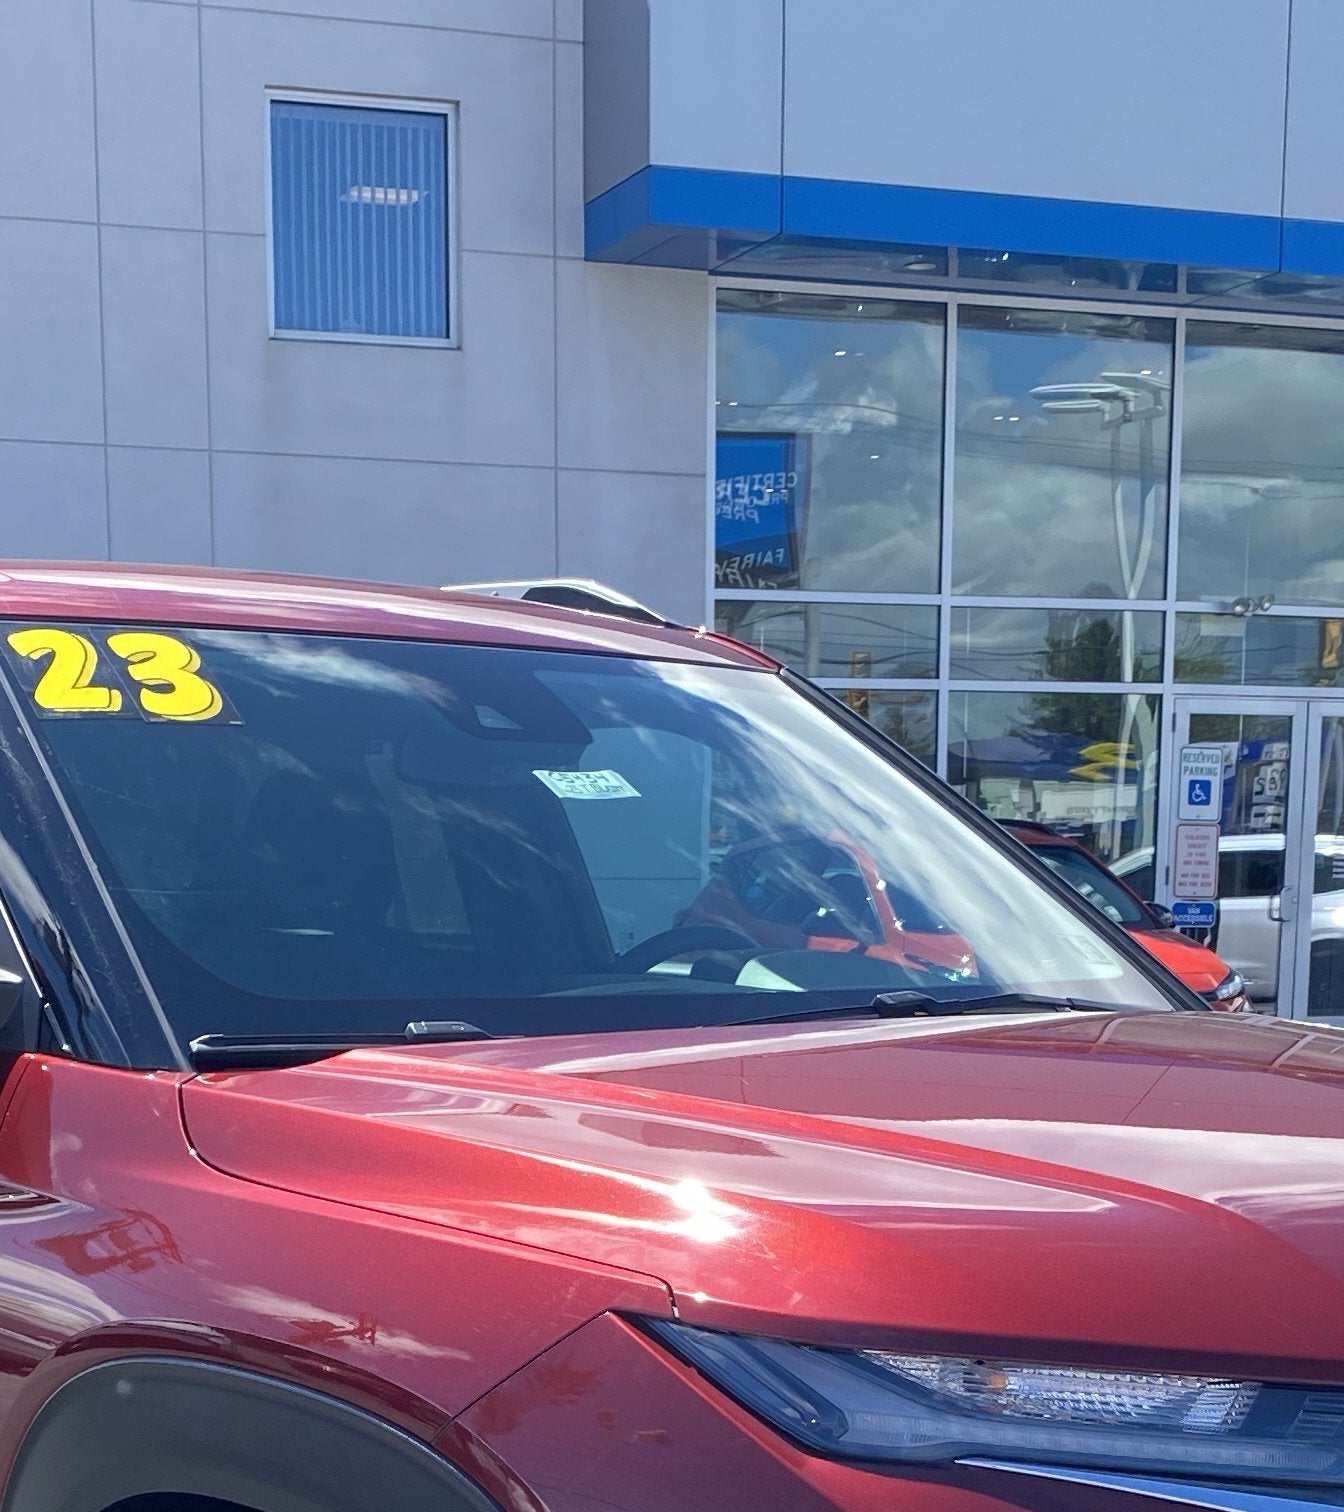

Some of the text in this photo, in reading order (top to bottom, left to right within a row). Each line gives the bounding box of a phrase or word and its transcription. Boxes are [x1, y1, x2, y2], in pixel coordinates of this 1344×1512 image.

[7, 629, 223, 721] 23
[1183, 752, 1220, 764] RESERVED
[1183, 766, 1218, 777] PARKING
